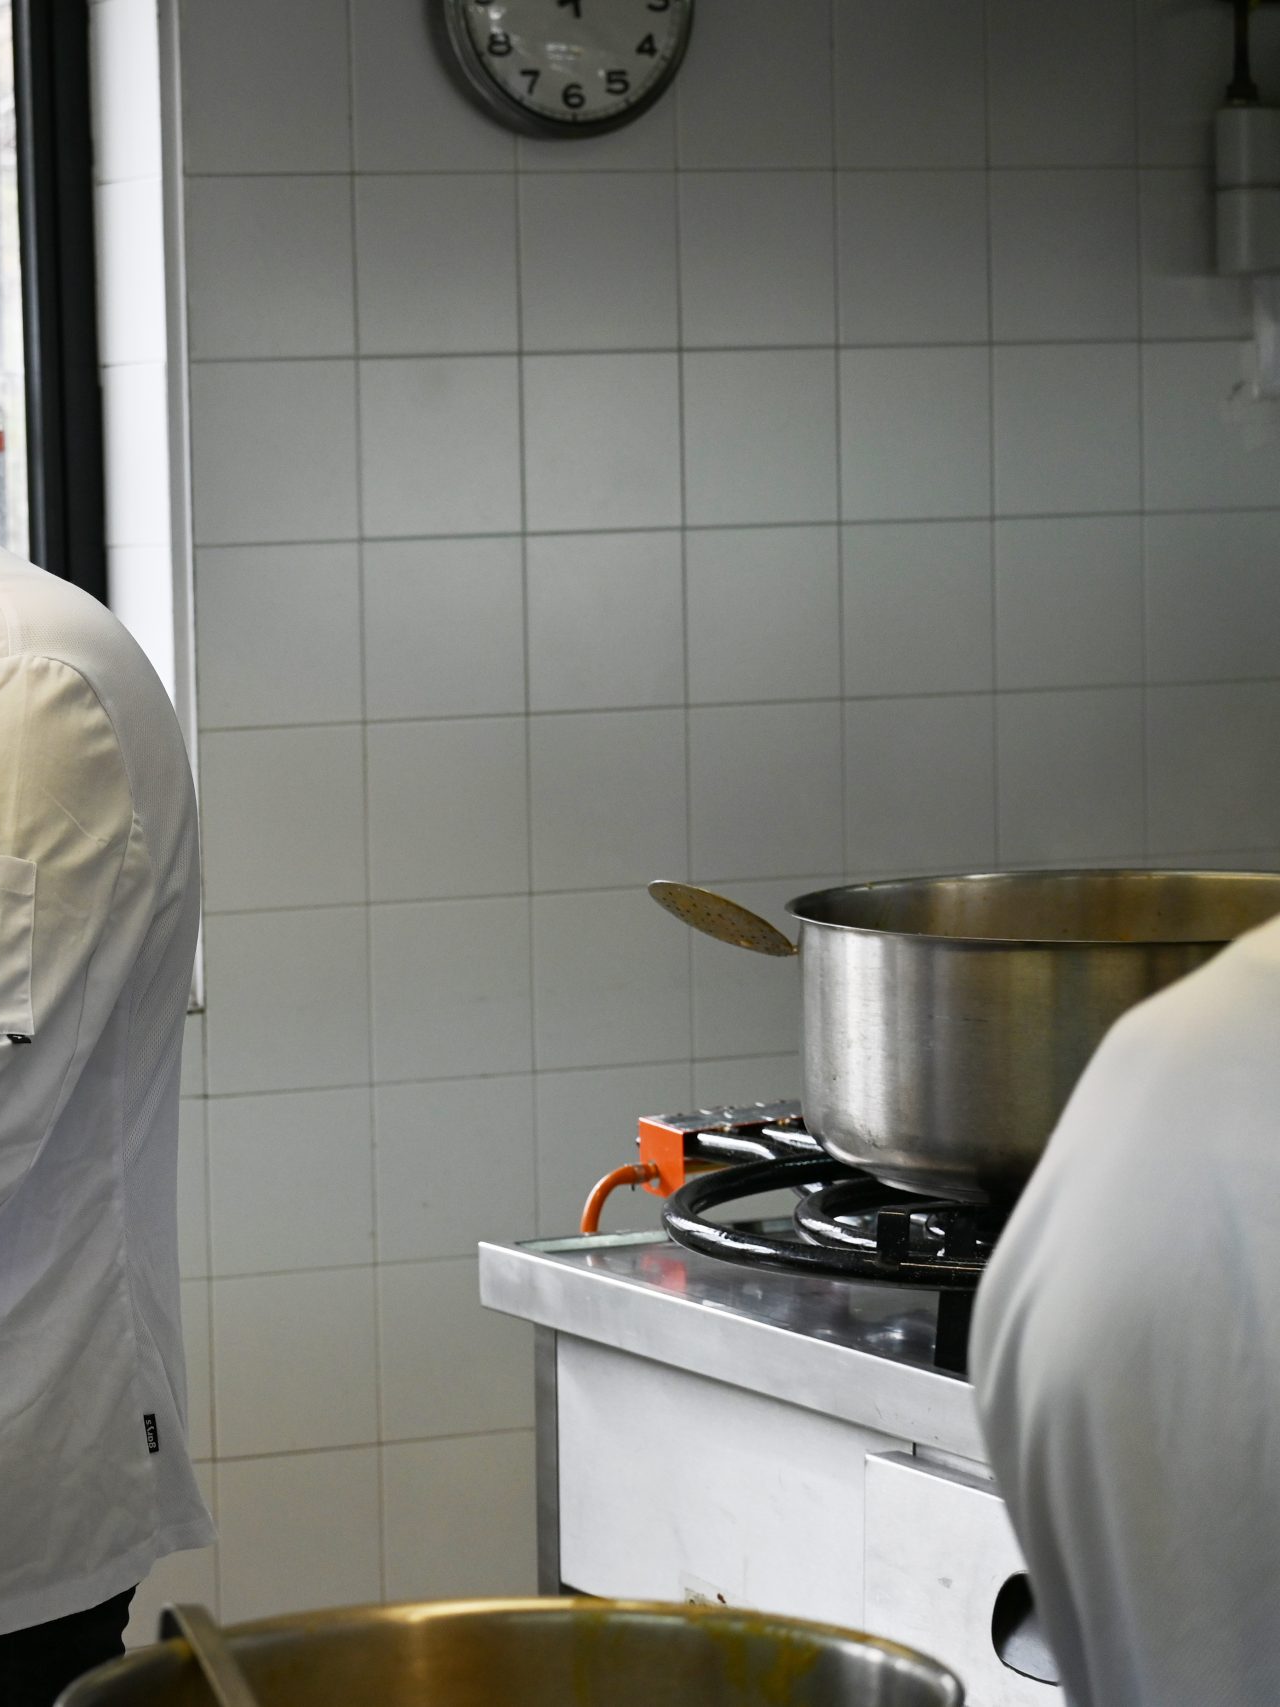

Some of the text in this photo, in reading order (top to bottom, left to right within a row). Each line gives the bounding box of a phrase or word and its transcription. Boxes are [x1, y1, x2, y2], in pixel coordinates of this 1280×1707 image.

[487, 32, 512, 57] 8
[636, 33, 658, 58] 4
[520, 70, 540, 95] 7
[605, 70, 630, 95] 5
[561, 84, 586, 109] 6
